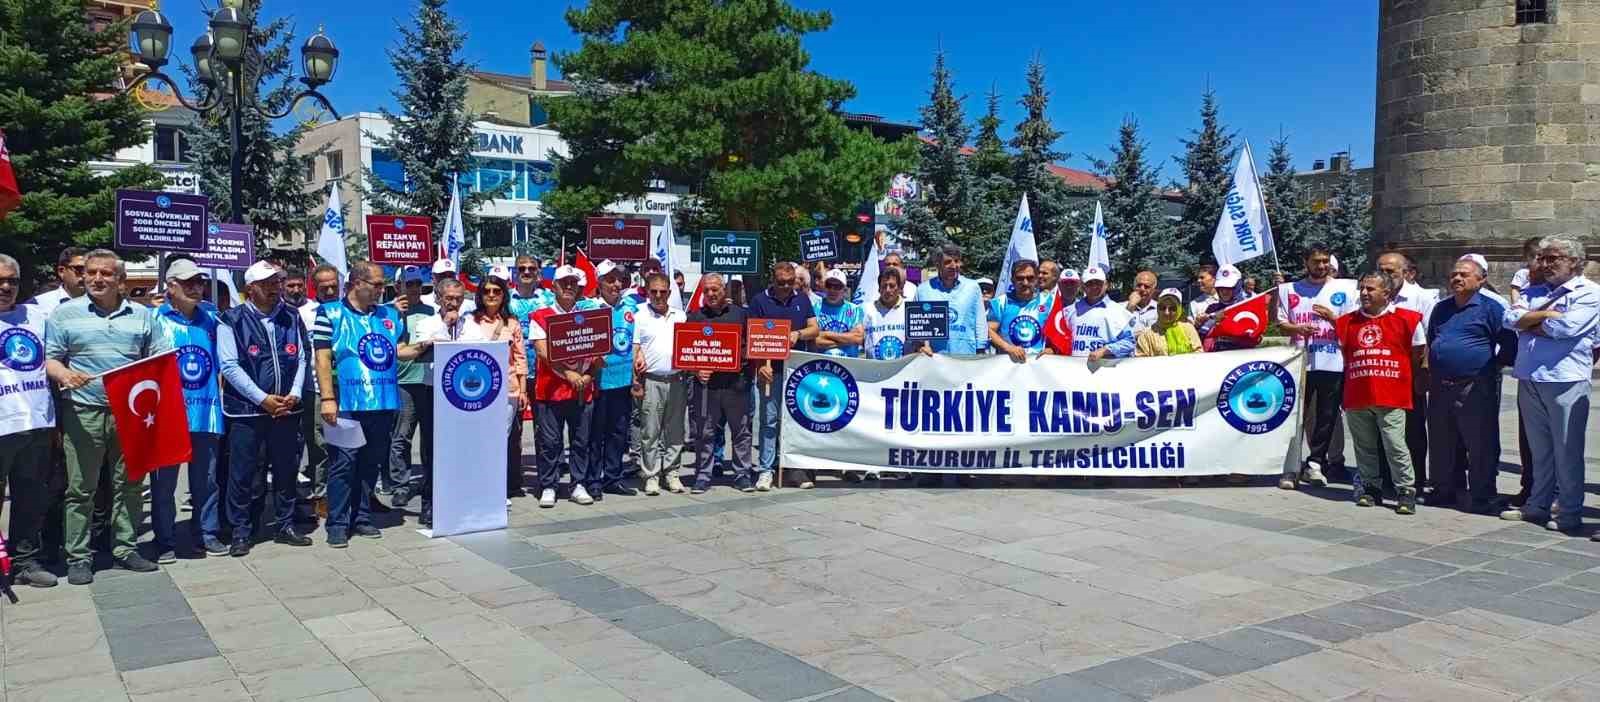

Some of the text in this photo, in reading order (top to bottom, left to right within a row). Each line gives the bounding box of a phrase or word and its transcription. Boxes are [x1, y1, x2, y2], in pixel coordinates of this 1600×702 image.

[475, 132, 523, 154] BANK
[154, 210, 200, 221] GÜVENLİKTE
[154, 219, 180, 227] ÖNCESİ
[217, 238, 244, 246] ÖDEME
[710, 244, 751, 254] ÜCRETTE
[384, 250, 418, 259] İSTİYORUZ
[713, 258, 748, 266] ADALET
[566, 328, 580, 336] YENİ
[1076, 325, 1099, 337] TÜRK
[552, 339, 573, 347] TOPLU
[0, 384, 20, 396] ÜRK
[881, 381, 1197, 434] TÜRKİYE KAMU-SEN
[810, 423, 832, 432] 1992
[1246, 424, 1268, 433] 1992
[888, 442, 1185, 469] ERZURUM İL TEMSİLCİLİĞİ
